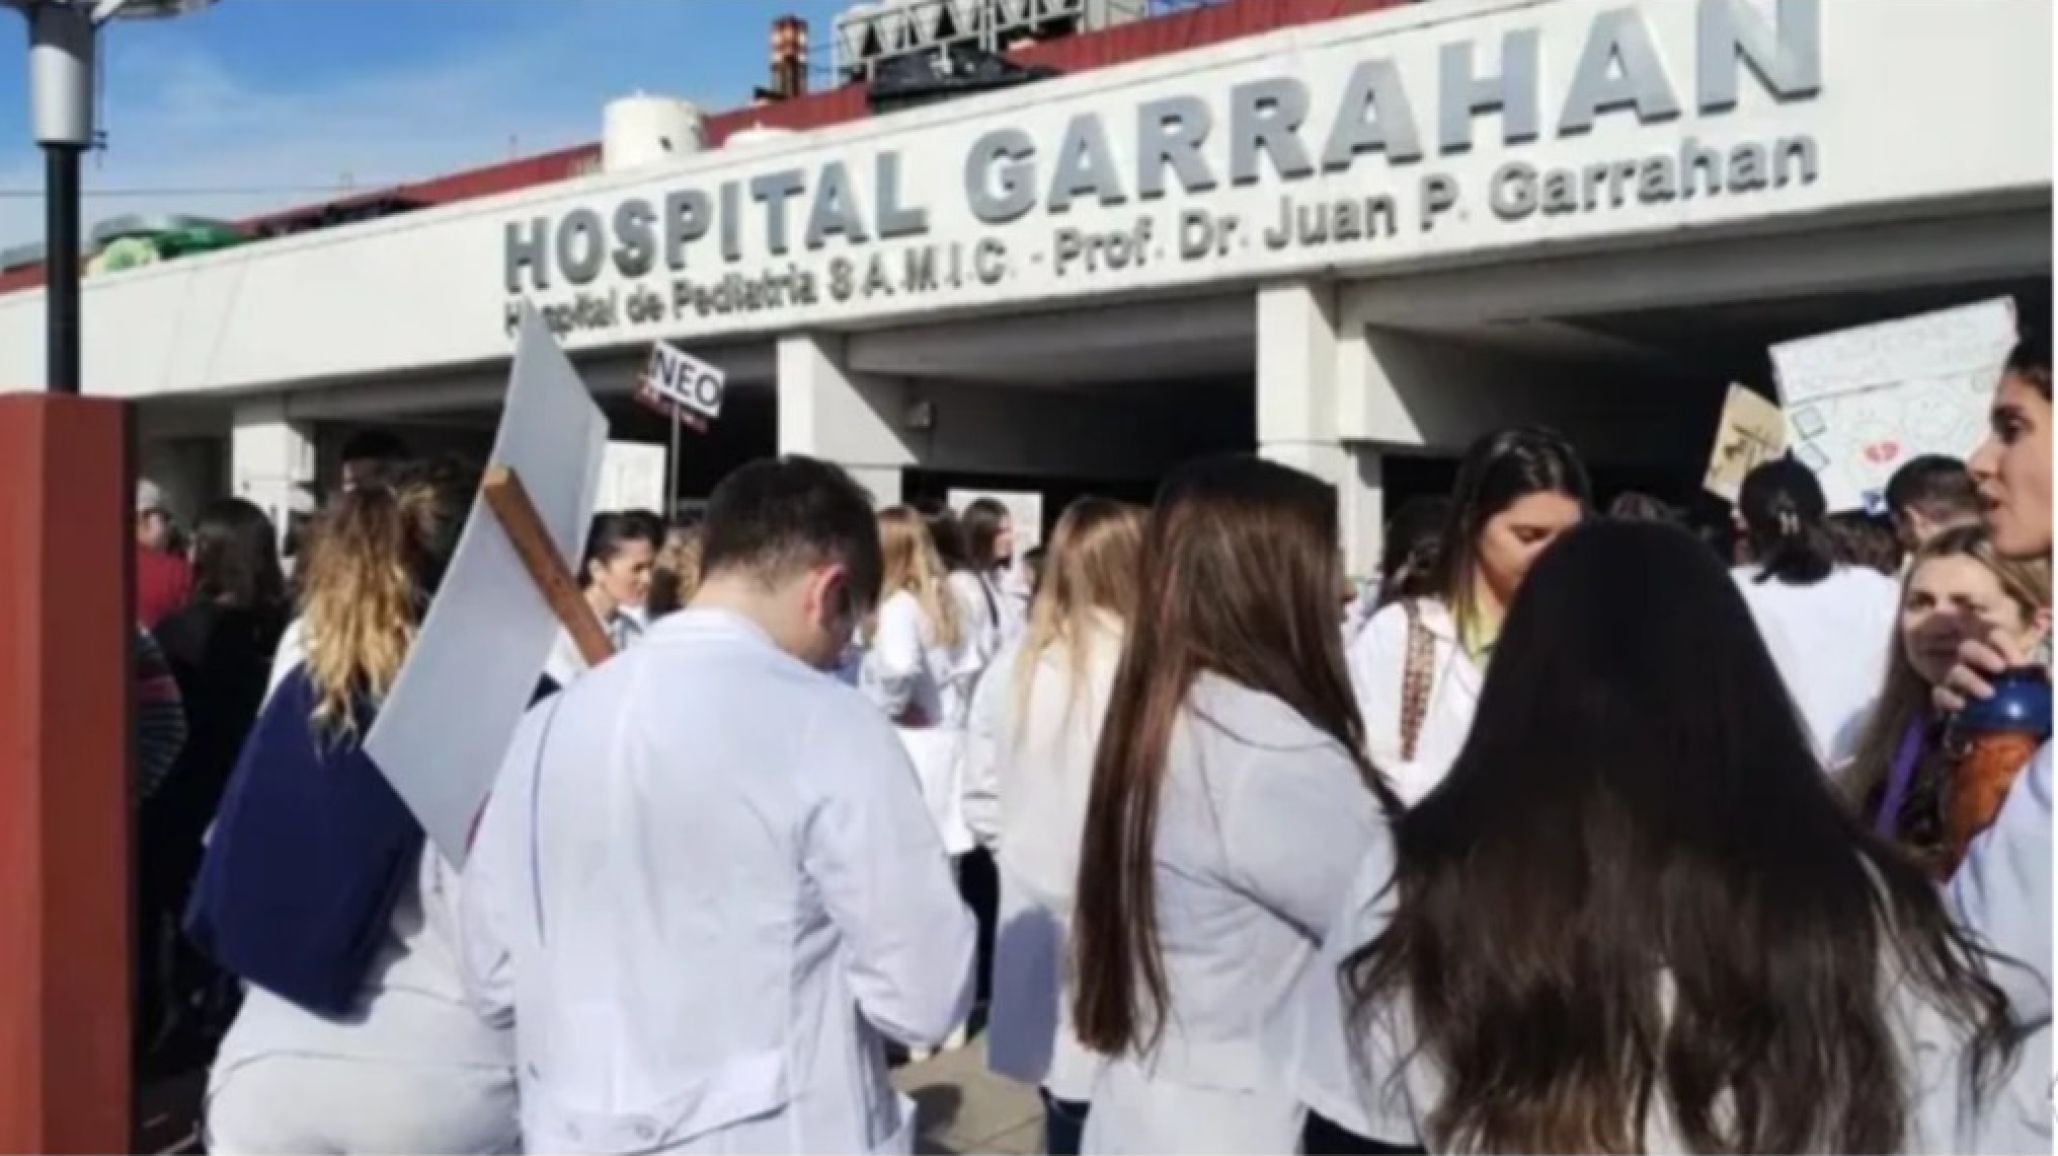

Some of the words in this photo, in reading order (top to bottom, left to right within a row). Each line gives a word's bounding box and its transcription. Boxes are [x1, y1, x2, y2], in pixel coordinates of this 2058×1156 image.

[504, 151, 929, 294] HOSPITAL
[965, 0, 1823, 224] GARRAHAN
[628, 284, 664, 323] de
[672, 262, 818, 320] Pediatria
[1264, 194, 1397, 251] Juan
[1488, 133, 1819, 222] Garrahan
[653, 348, 721, 408] NEO
